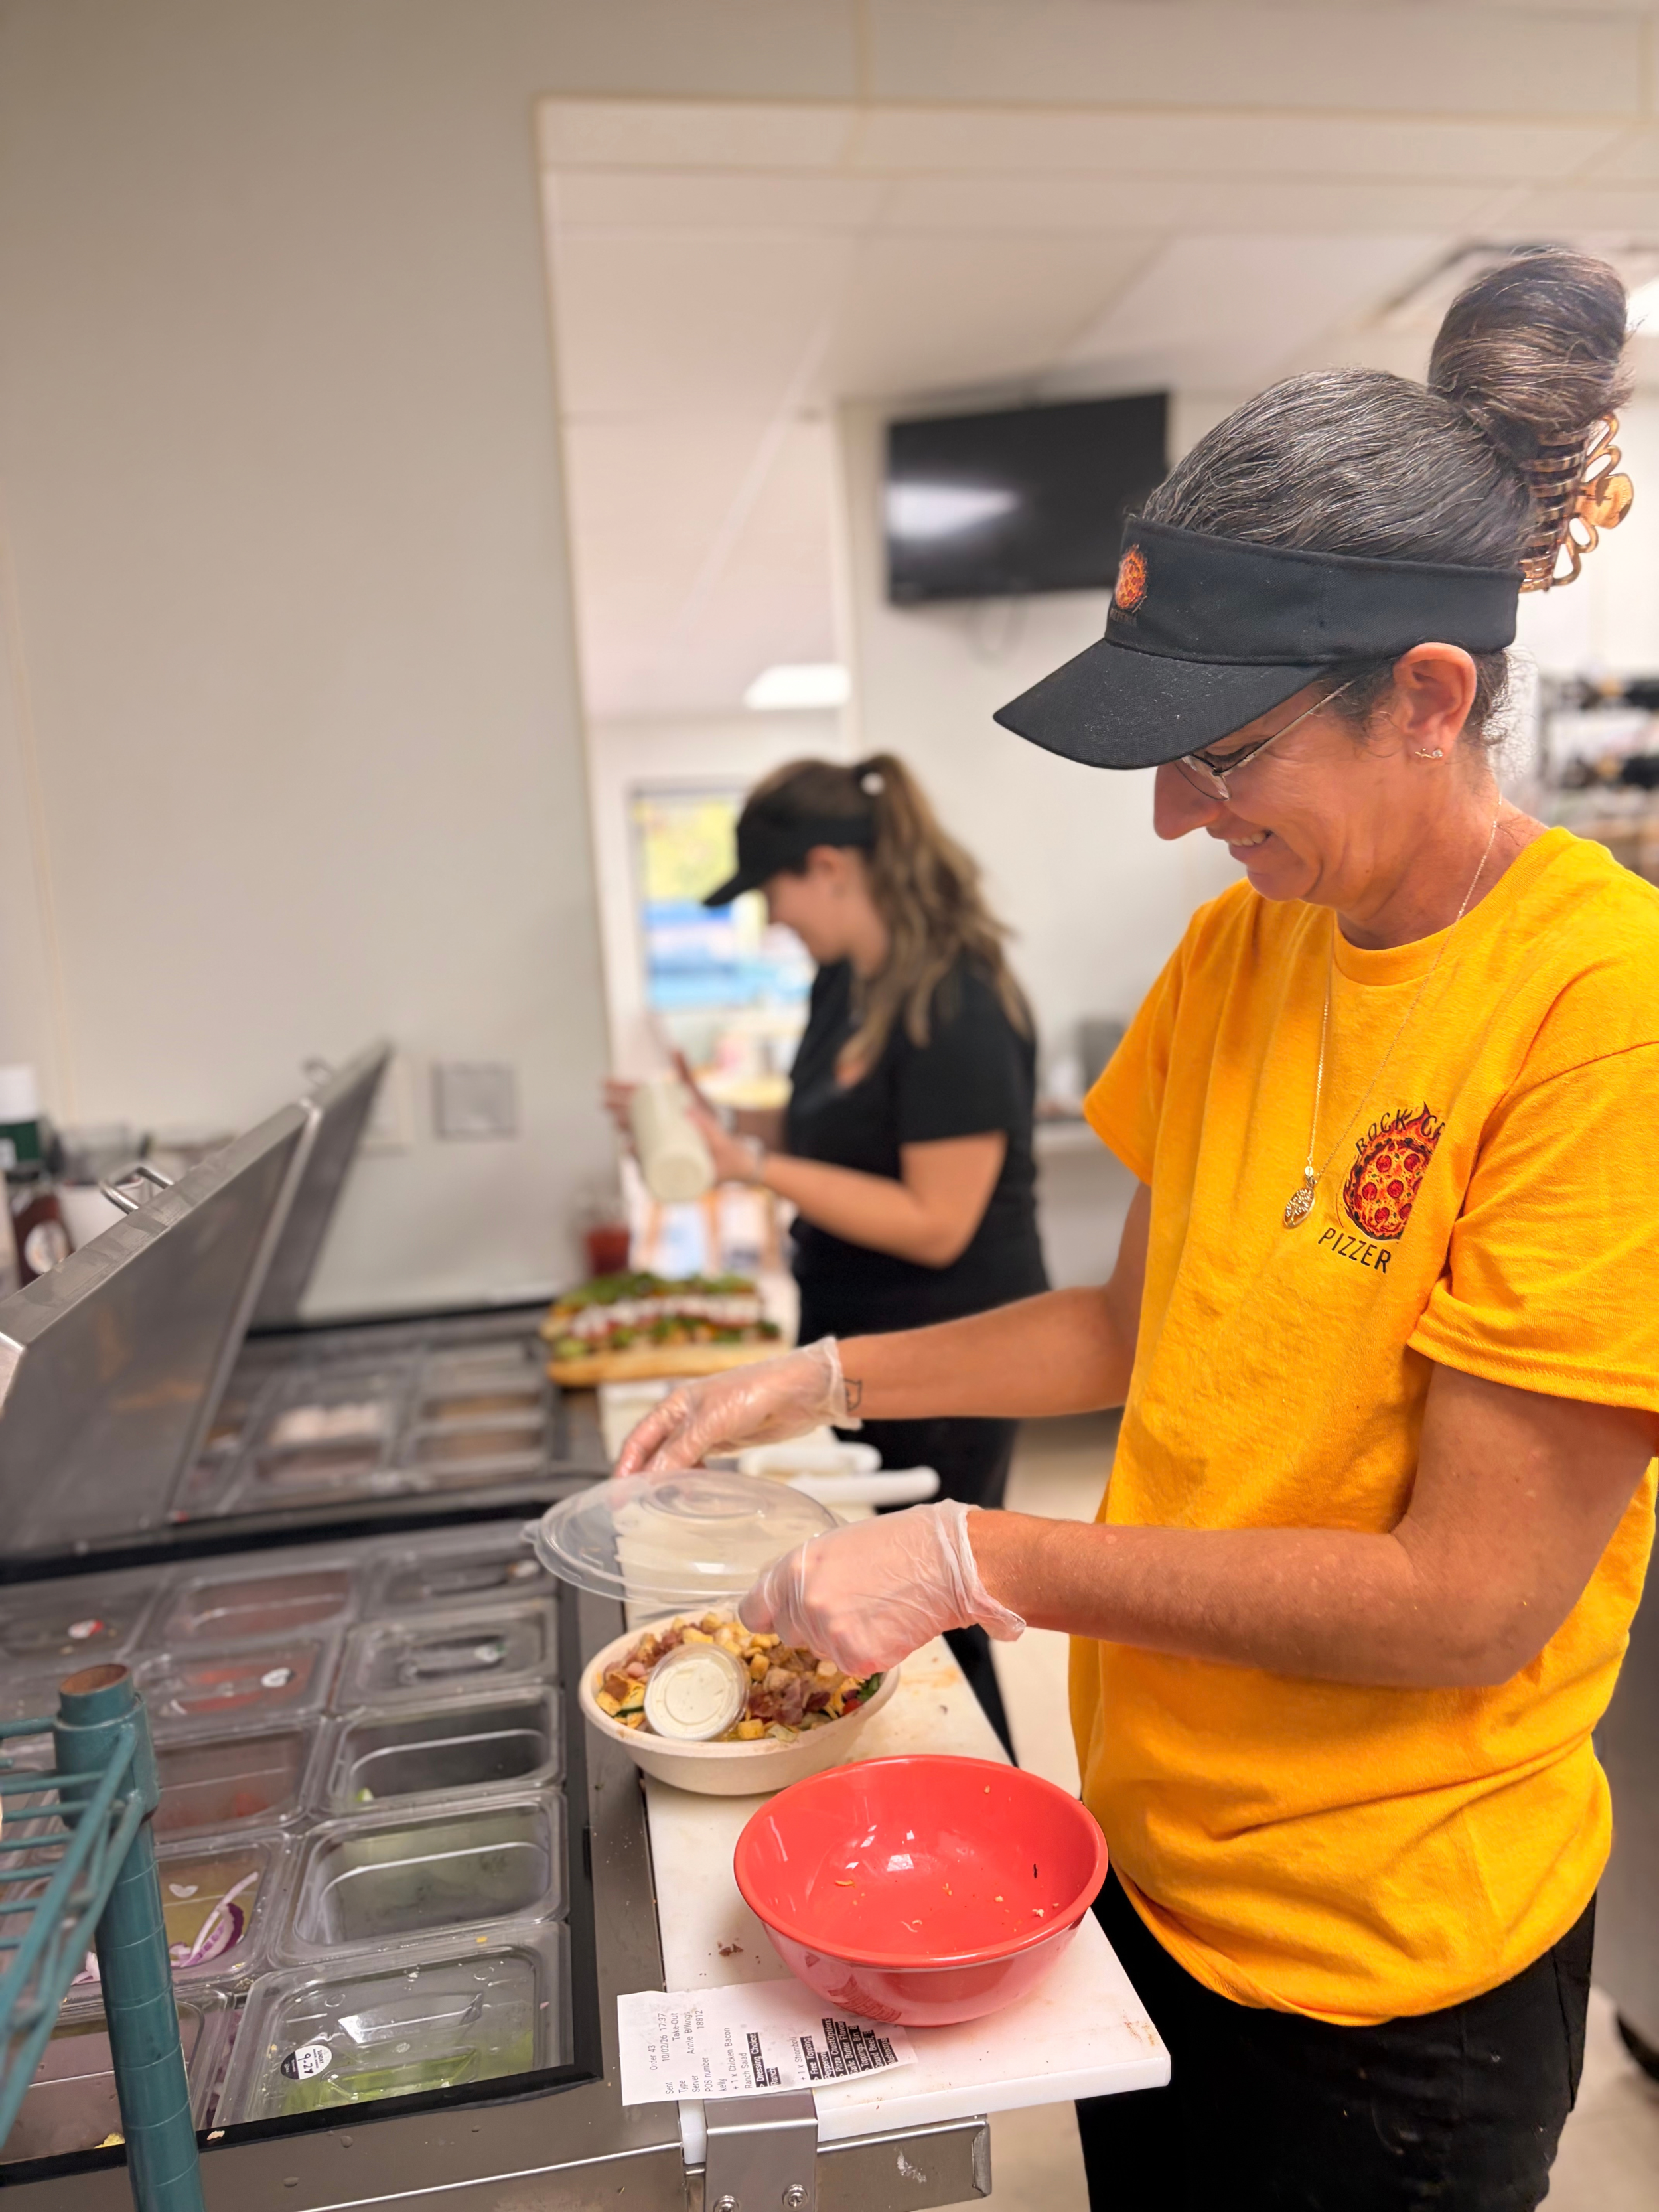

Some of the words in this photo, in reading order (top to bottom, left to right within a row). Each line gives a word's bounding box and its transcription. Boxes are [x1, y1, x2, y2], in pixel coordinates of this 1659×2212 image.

[1318, 1227, 1392, 1274] PIZZER
[671, 2013, 680, 2041] Take-Out
[684, 2012, 693, 2033] Billings
[695, 2010, 704, 2029] 18812
[837, 2022, 847, 2039] Flavor
[660, 2035, 670, 2061] 10/02/26
[685, 2037, 695, 2054] Annie
[790, 2037, 802, 2062] Stromboli
[841, 2042, 853, 2058] Butter
[857, 2043, 870, 2066] Toppings
[649, 2055, 658, 2070] Order
[702, 2057, 711, 2077] number
[727, 2049, 737, 2071] Chicken
[739, 2053, 749, 2068] Salad
[754, 2056, 765, 2081] Dressing
[821, 2052, 831, 2078] Pepperon
[833, 2057, 844, 2071] Pizza
[847, 2060, 857, 2074] Garlic
[871, 2053, 883, 2067] Ground
[691, 2075, 700, 2092] Server
[718, 2079, 727, 2091] kelly
[741, 2071, 753, 2089] Ranch
[768, 2067, 778, 2085] Ranch
[679, 2080, 688, 2093] Type
